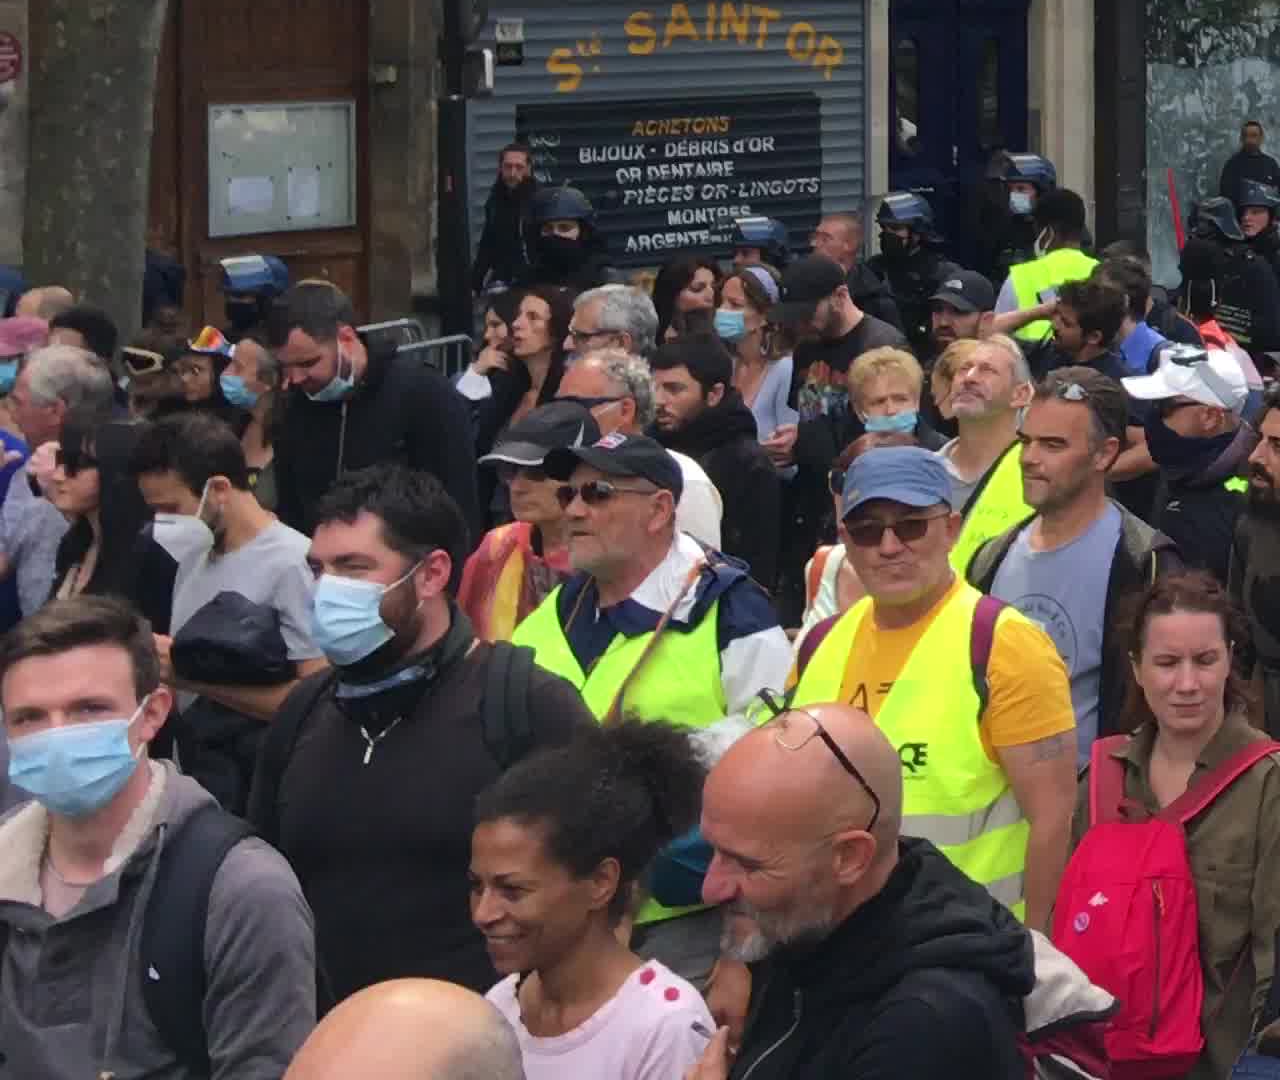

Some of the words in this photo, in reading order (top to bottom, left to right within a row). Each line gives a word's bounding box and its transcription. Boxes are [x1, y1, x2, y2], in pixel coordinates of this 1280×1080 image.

[624, 0, 781, 56] SAINT
[785, 22, 843, 81] OR
[631, 116, 730, 137] ACHETONS
[579, 143, 646, 164] BIJOUX
[665, 139, 729, 158] DÉBRIS
[616, 166, 641, 185] OR
[647, 160, 735, 181] DENTAIRE
[623, 182, 694, 206] PIÈCES
[701, 177, 821, 201] OR-LINGOTS
